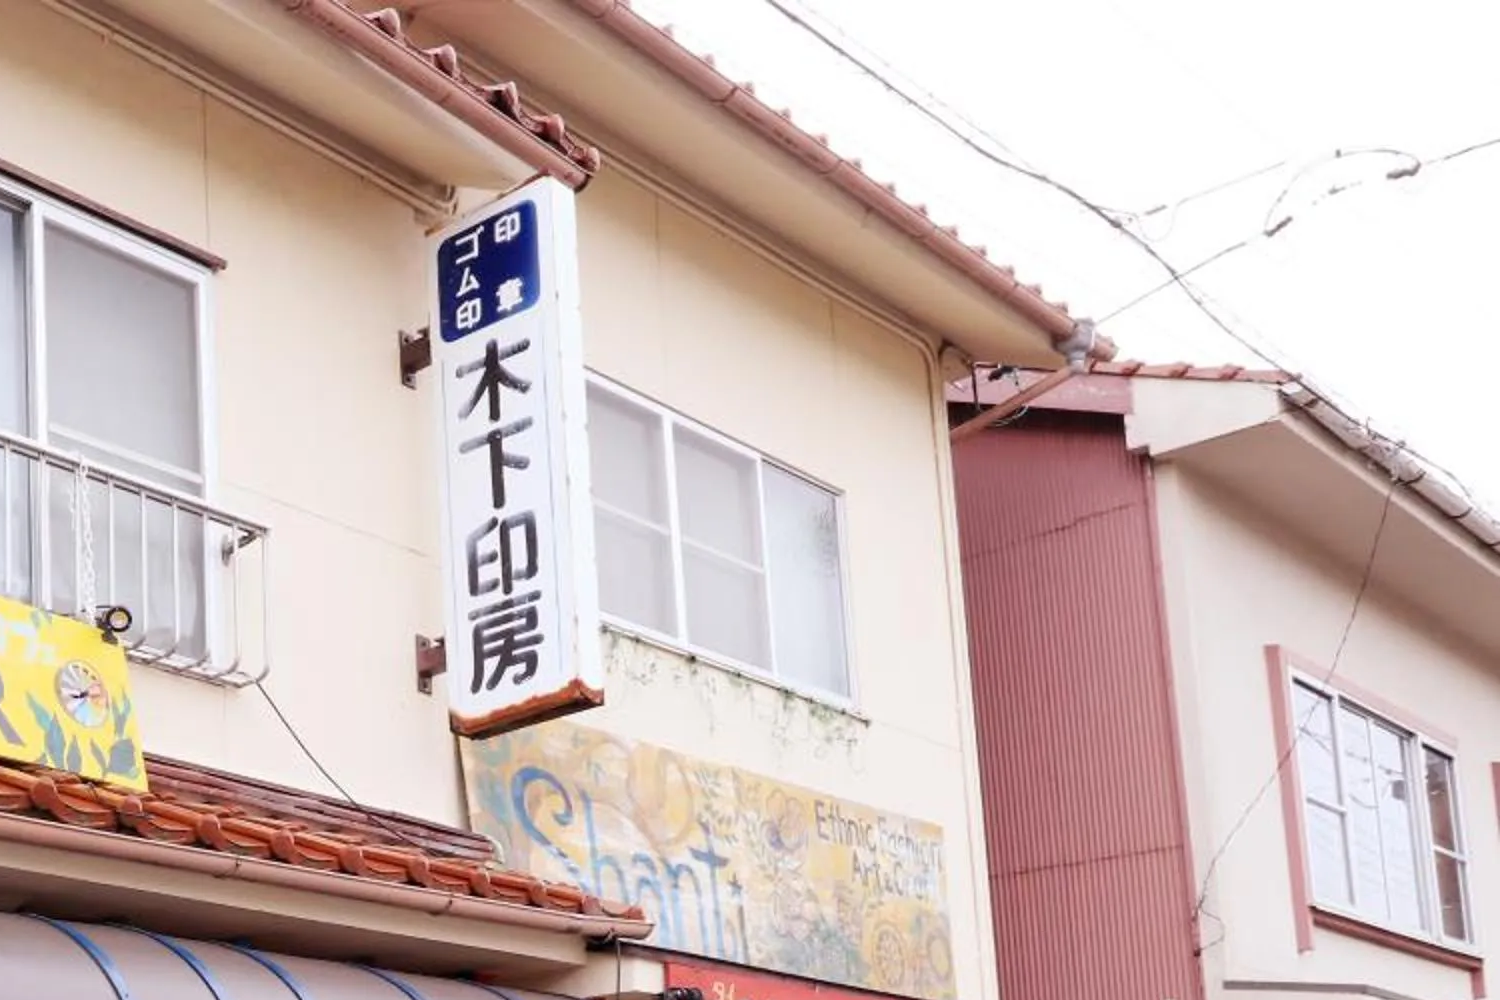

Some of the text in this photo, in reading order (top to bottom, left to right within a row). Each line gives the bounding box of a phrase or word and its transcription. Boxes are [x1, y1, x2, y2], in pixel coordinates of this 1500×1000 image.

[455, 224, 485, 330] ゴム印
[456, 337, 544, 694] 木下印房
[814, 799, 877, 852] Ethnic
